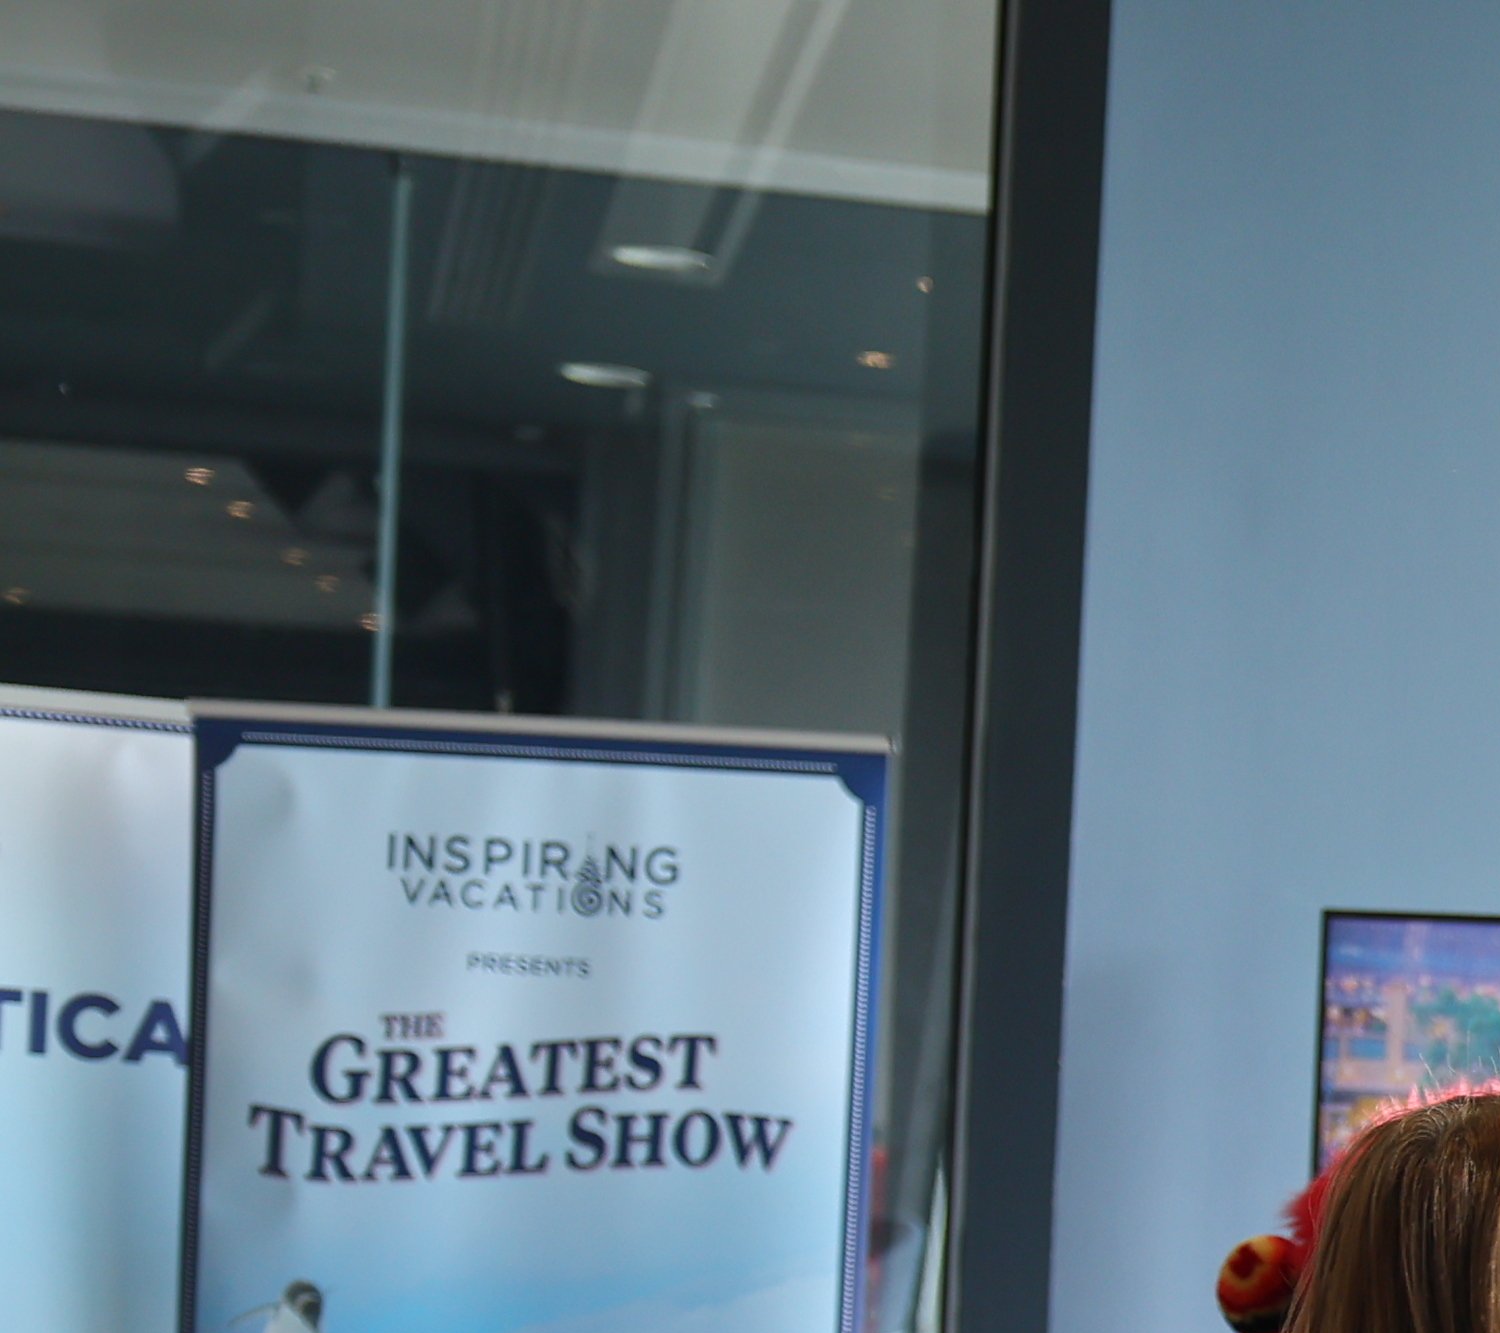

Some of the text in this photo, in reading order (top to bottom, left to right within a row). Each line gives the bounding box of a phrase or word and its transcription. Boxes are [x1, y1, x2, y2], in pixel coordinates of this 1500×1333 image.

[386, 832, 681, 887] INSPIRING
[401, 878, 665, 919] VACATIONS
[466, 951, 591, 980] PRESENTS
[380, 1013, 443, 1040] THE
[311, 1034, 717, 1105] GREATEST
[248, 1103, 795, 1182] TRAVEL SHOW
